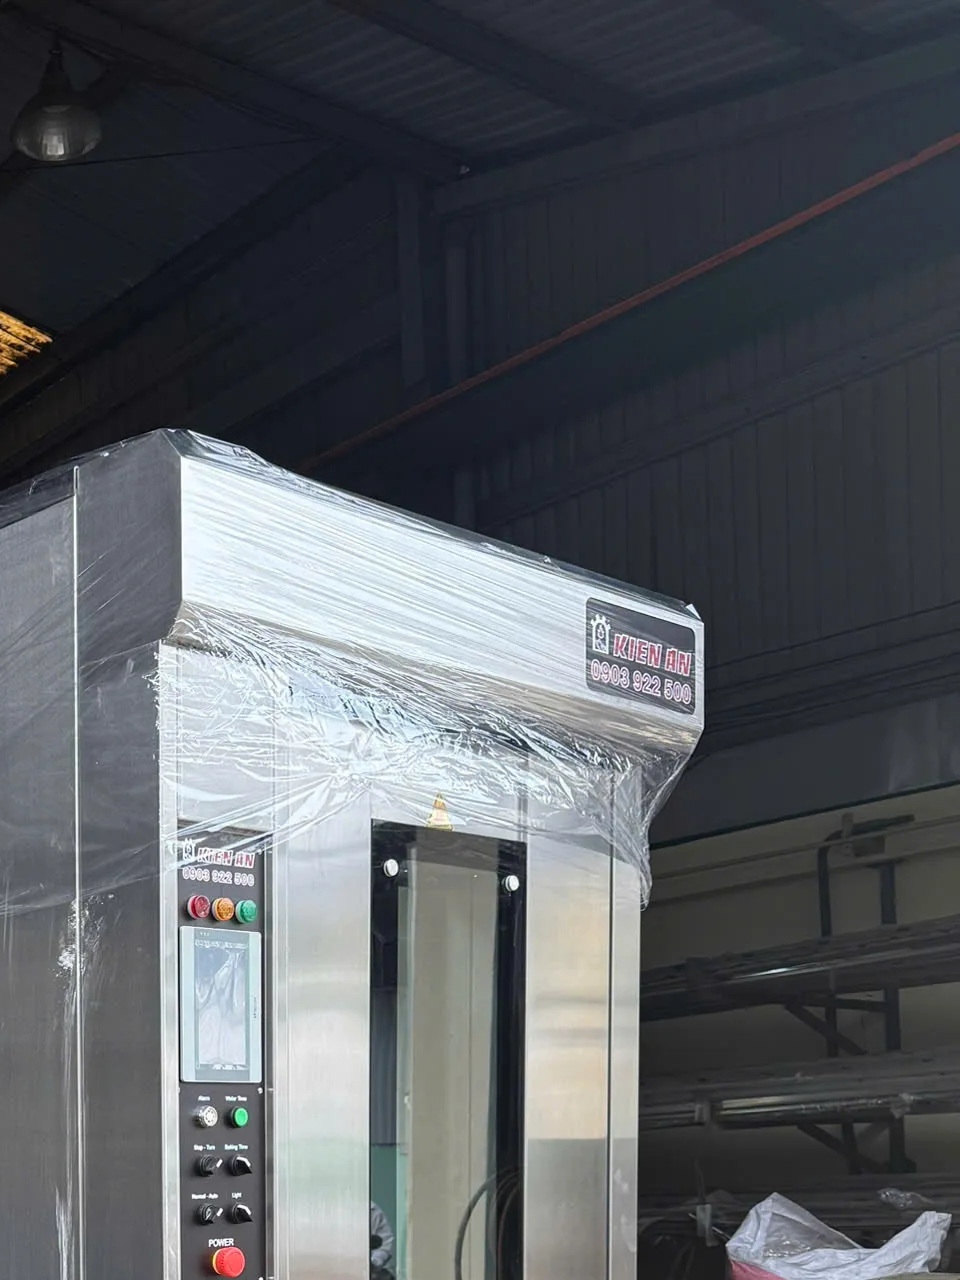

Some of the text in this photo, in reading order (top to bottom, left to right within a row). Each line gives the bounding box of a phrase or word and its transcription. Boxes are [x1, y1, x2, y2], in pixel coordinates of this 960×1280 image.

[613, 633, 692, 677] KIEN AN
[591, 659, 691, 704] 0903 922 500
[234, 851, 255, 868] AN
[182, 867, 210, 882] 0903
[211, 869, 232, 884] 922
[208, 1238, 234, 1247] POWER
